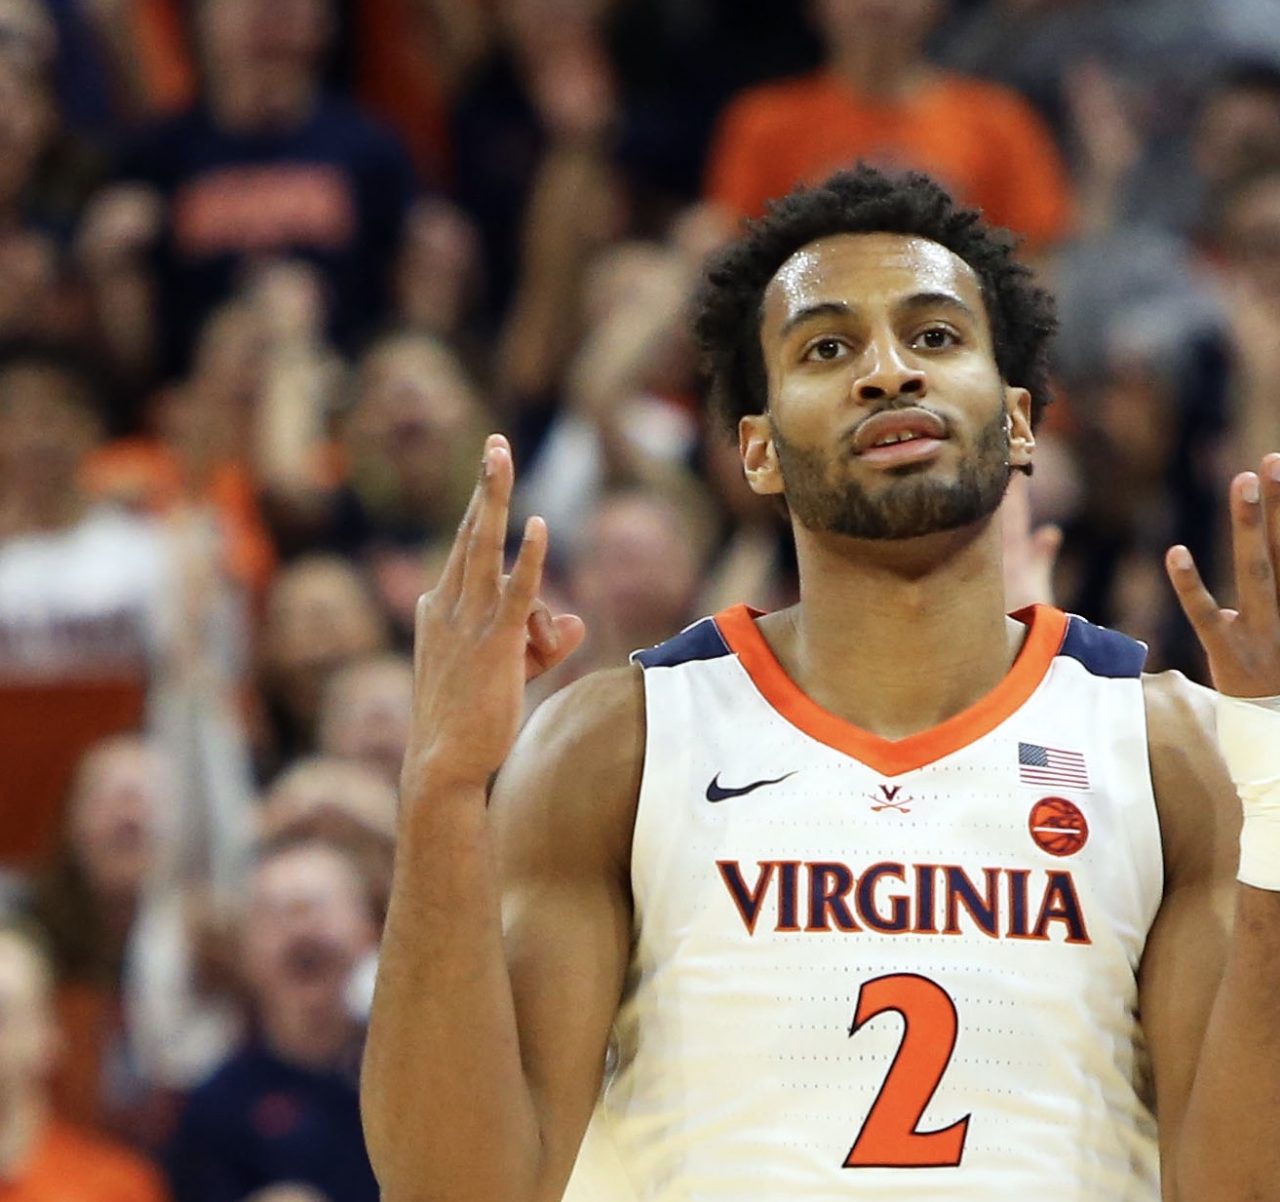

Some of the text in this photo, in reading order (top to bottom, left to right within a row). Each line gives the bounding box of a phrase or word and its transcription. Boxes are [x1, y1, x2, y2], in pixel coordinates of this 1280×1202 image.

[878, 785, 902, 801] V
[715, 860, 1092, 945] VIRGINIA
[842, 973, 971, 1169] 2
